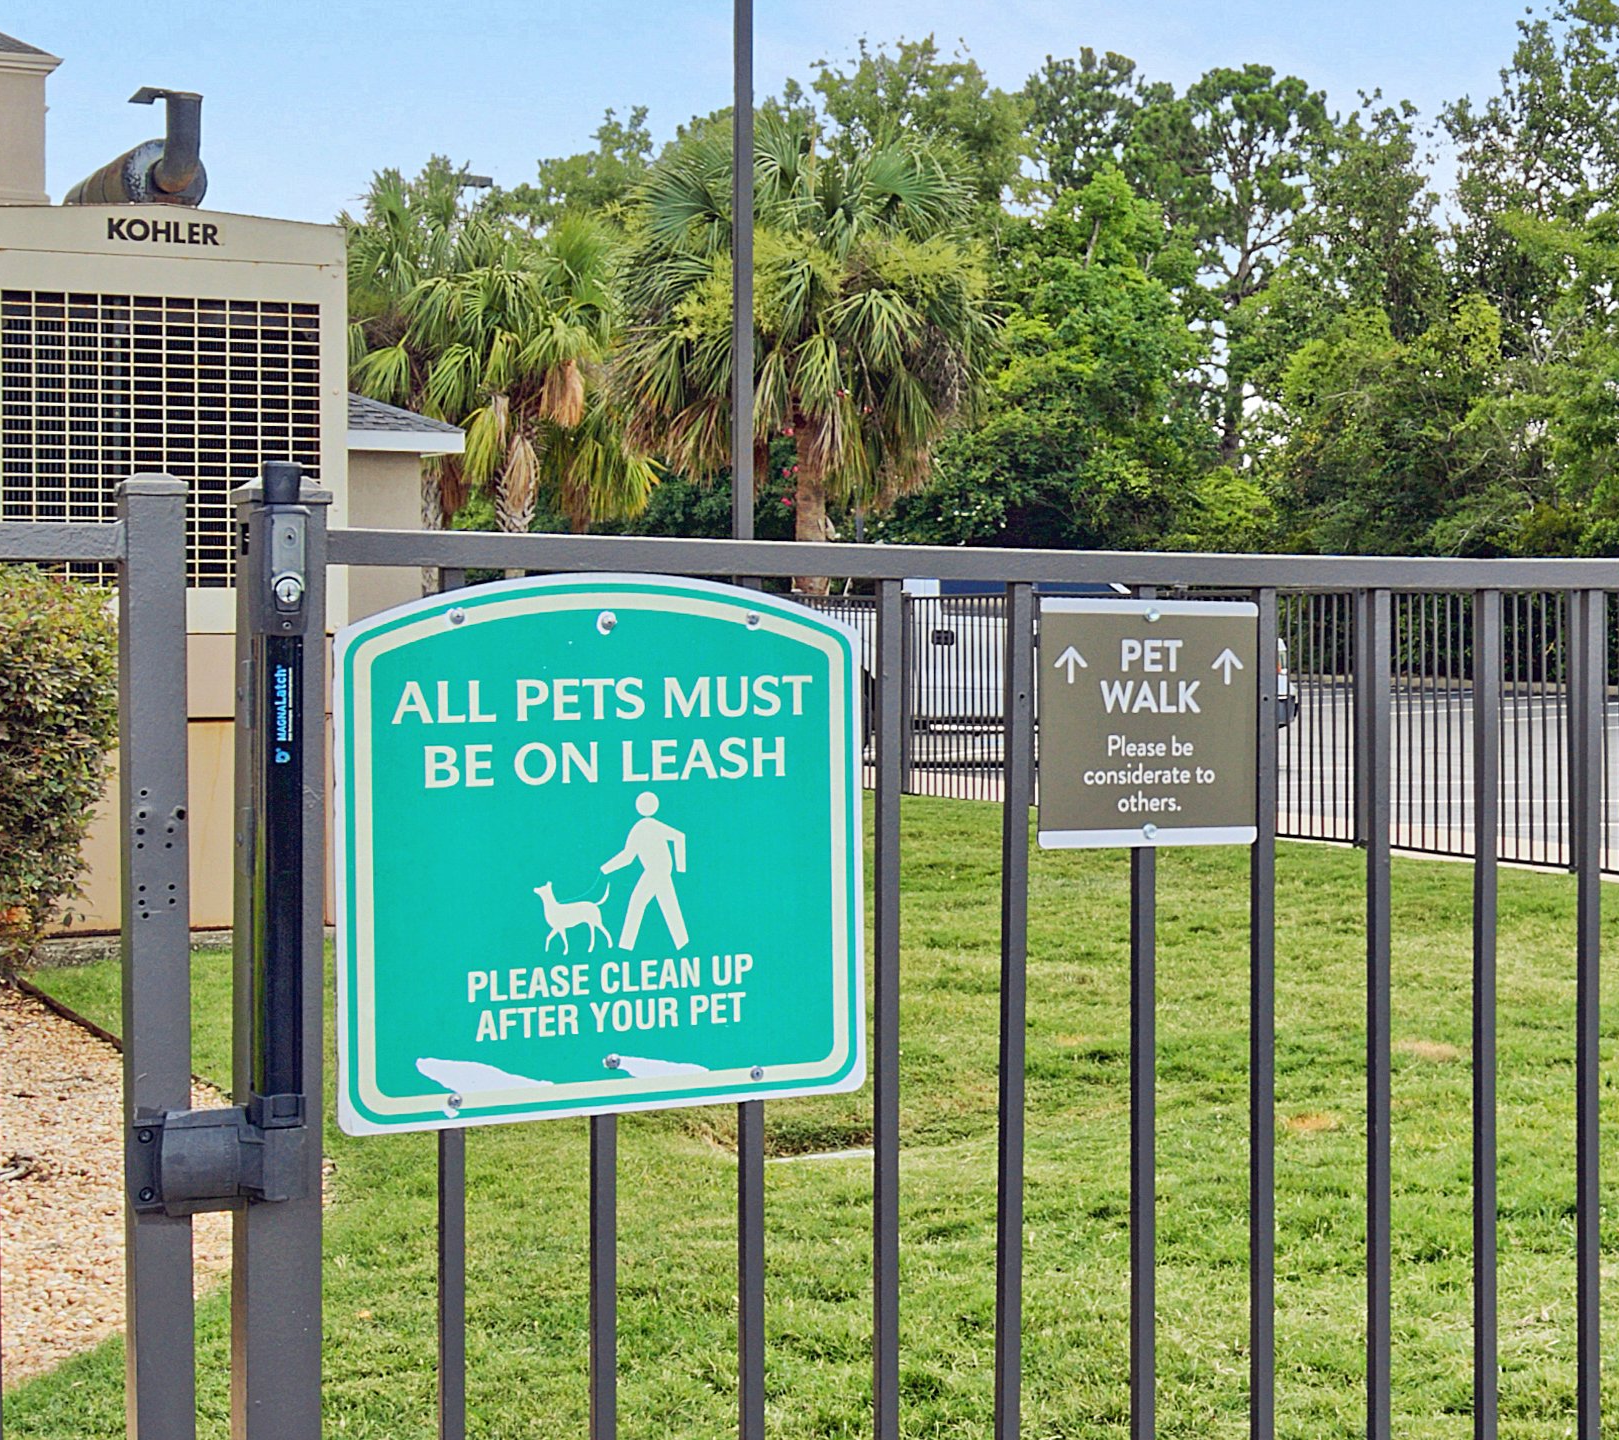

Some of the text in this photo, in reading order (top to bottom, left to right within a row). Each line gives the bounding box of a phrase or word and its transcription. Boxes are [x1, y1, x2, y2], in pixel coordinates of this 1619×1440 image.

[108, 218, 219, 245] KOHLER
[1122, 639, 1183, 672] PET
[392, 675, 812, 724] ALL PETS MUST
[1100, 680, 1201, 713] WALK
[1108, 735, 1193, 756] Please be
[425, 737, 785, 788] BE ON LEASH
[1084, 763, 1215, 785] considerate to
[1118, 791, 1181, 812] others.
[468, 954, 753, 1002] PLEASE CLEAN UP
[476, 992, 746, 1041] AFTER YOUR PET
